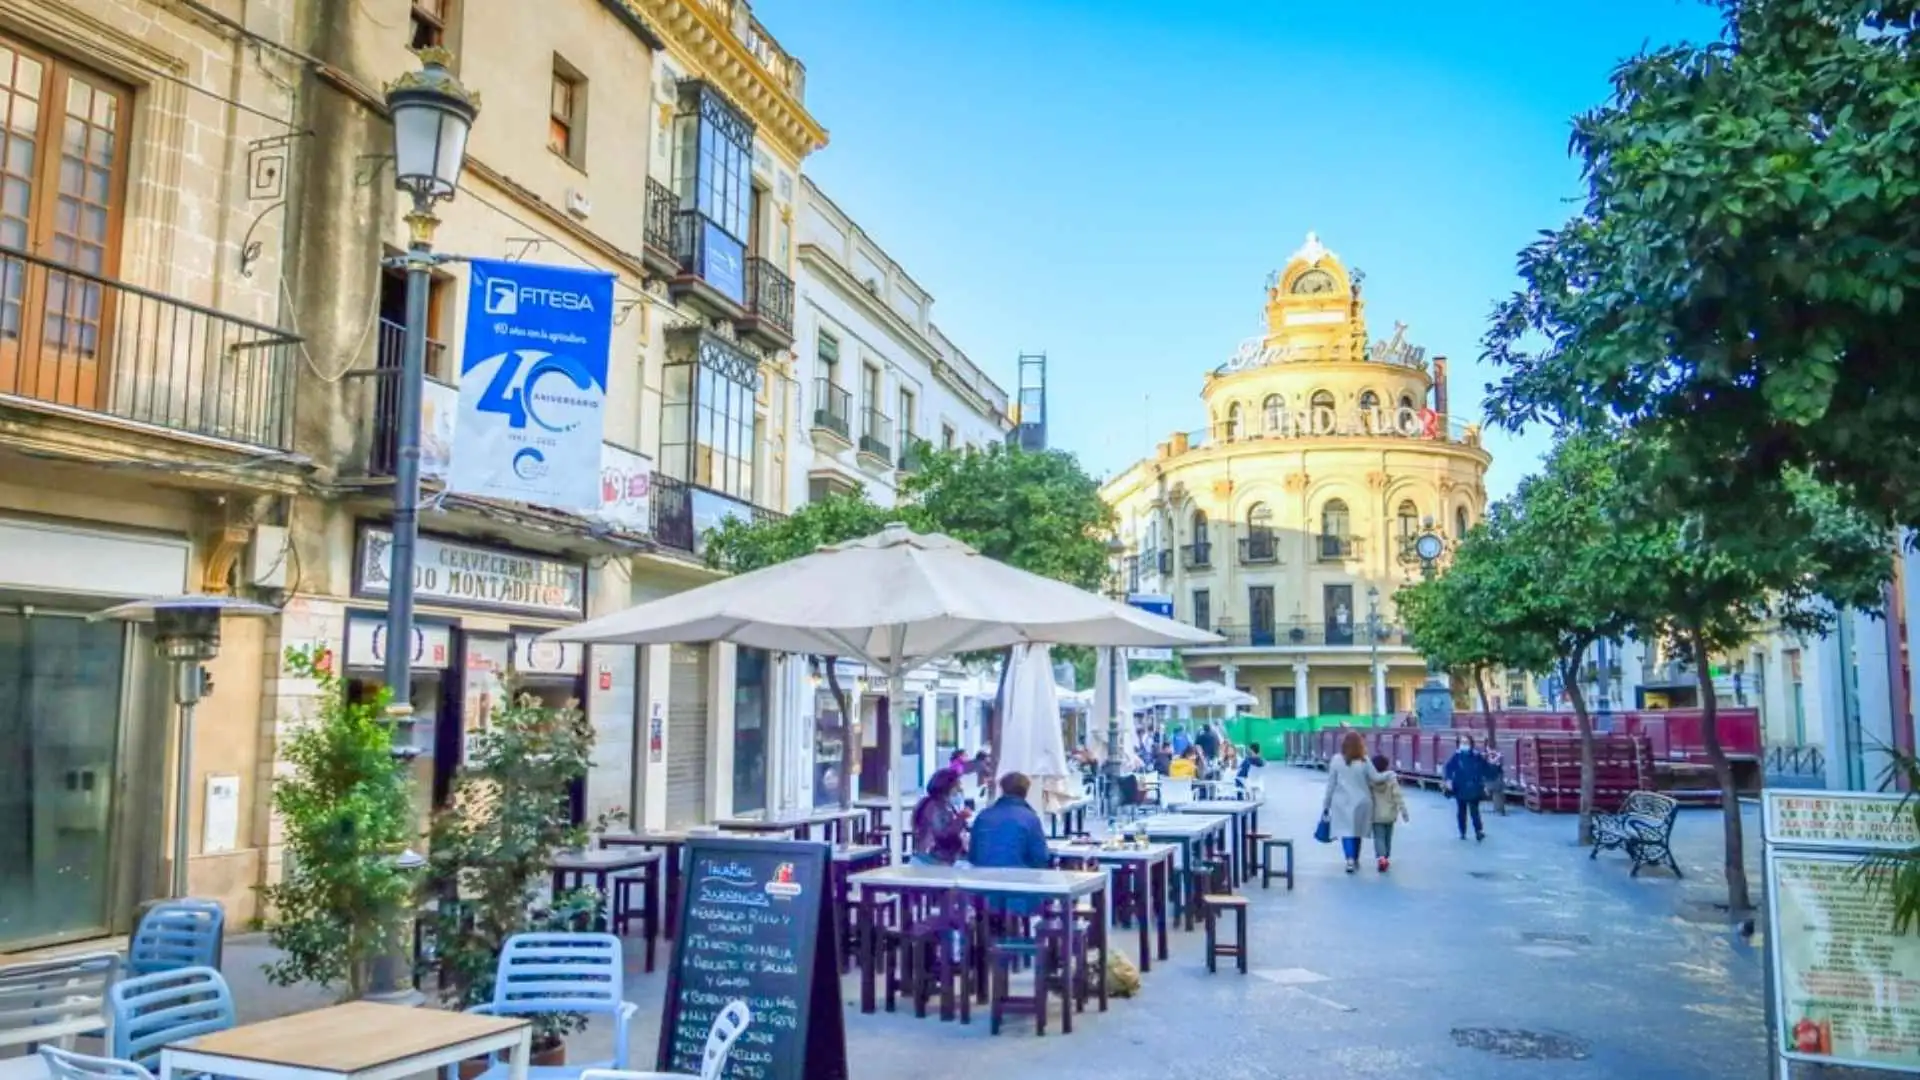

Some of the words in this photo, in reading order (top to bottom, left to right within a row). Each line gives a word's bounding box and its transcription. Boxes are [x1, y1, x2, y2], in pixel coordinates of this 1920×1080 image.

[519, 286, 595, 313] FITESA
[533, 392, 600, 409] ANIVERSARIO
[446, 571, 566, 606] MONTADITOS
